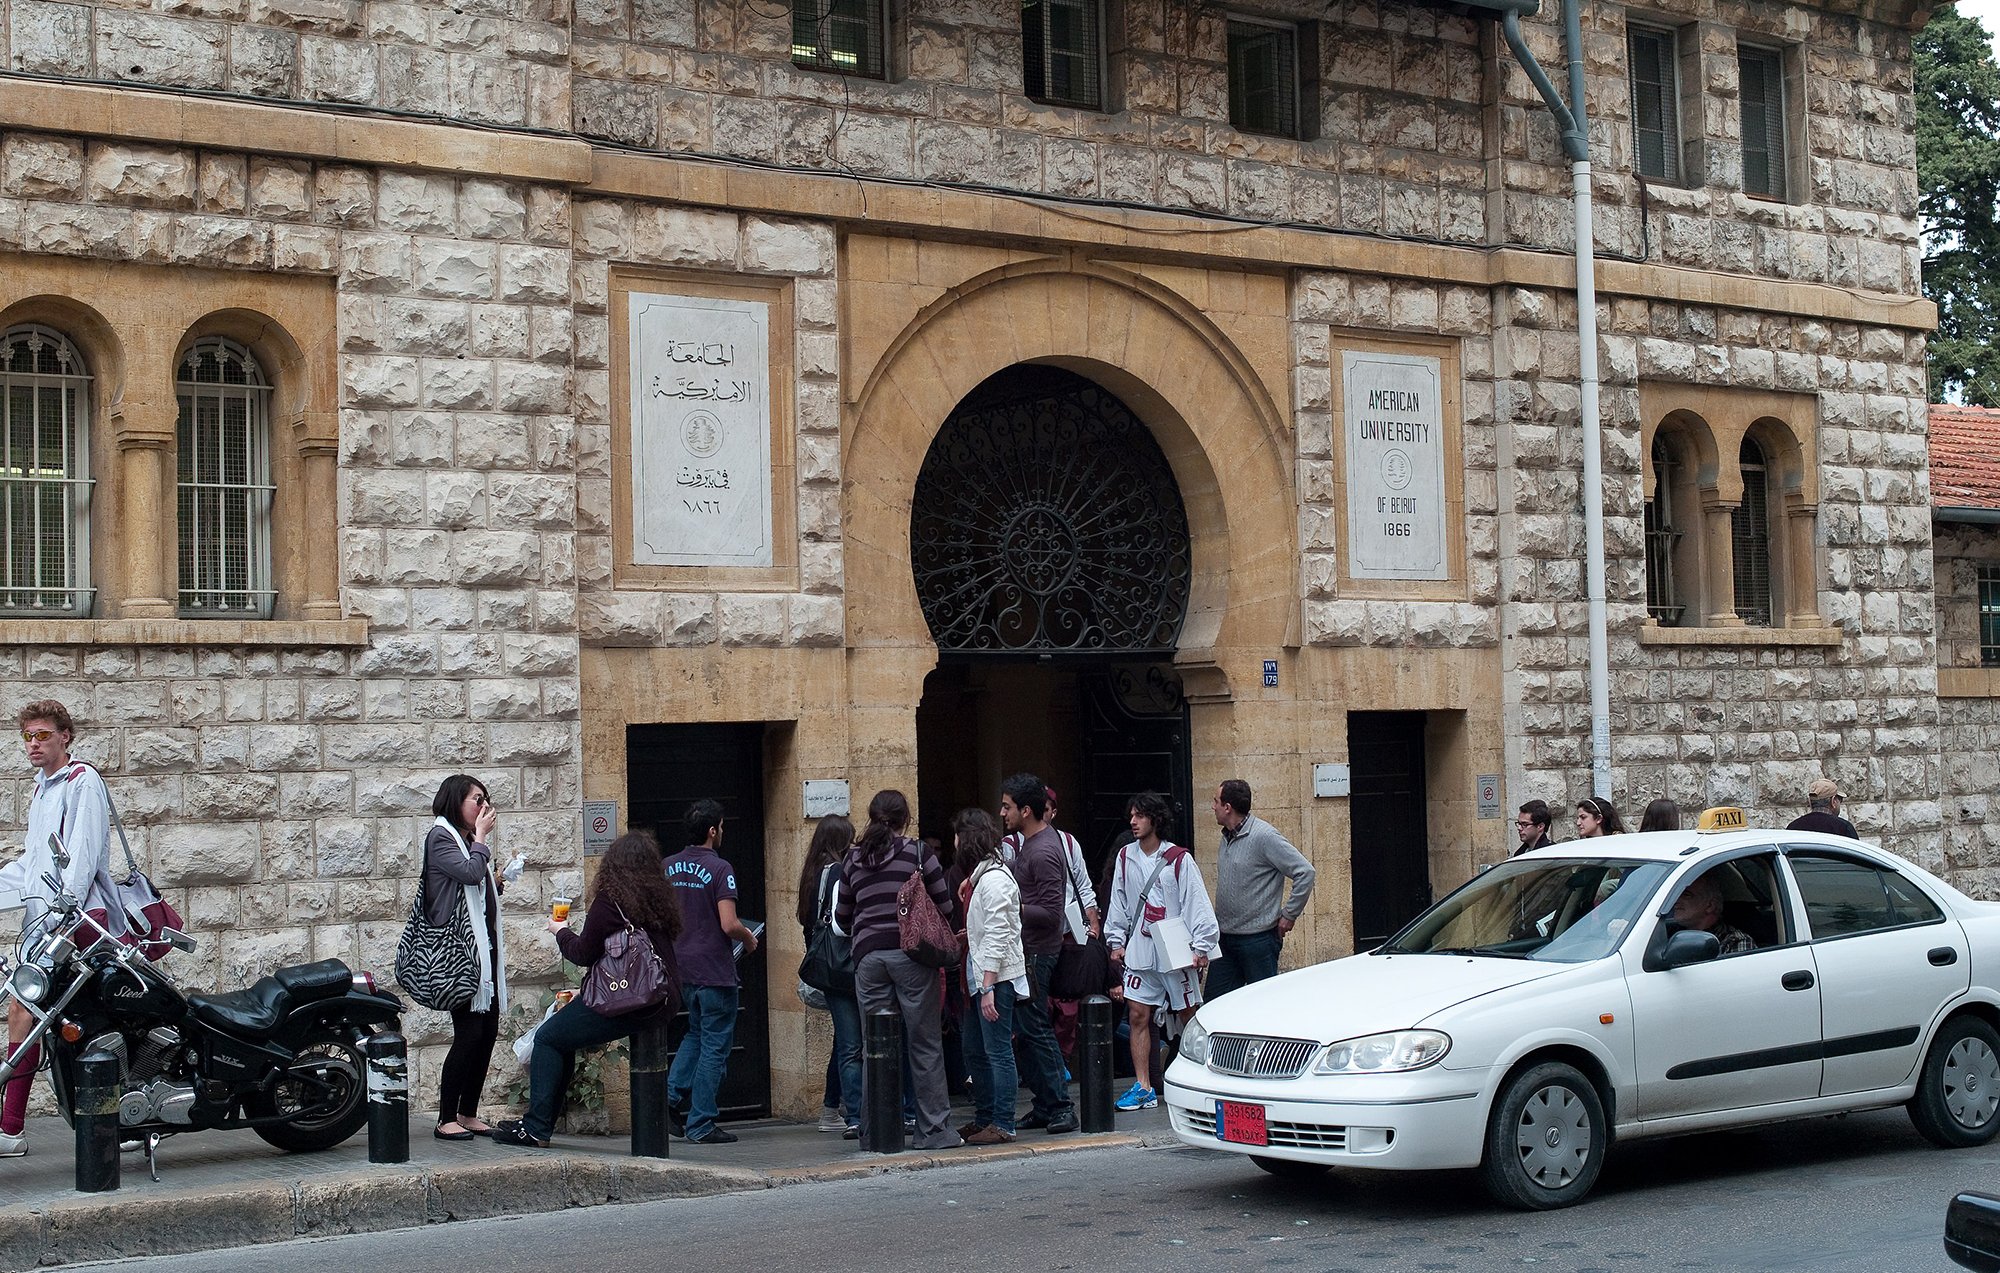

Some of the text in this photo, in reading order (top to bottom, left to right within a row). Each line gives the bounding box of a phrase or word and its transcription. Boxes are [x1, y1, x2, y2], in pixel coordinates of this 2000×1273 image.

[1368, 389, 1420, 413] AMERICAN
[1360, 419, 1429, 444] UNIVERSITY
[682, 499, 721, 514] ١٨٦٦
[1377, 496, 1417, 515] OF BEIRUT
[1383, 522, 1411, 537] 1866
[1264, 661, 1277, 672] ١٧٩
[1265, 675, 1277, 685] 179
[1714, 811, 1743, 827] TAXI
[726, 874, 737, 890] 8
[1126, 973, 1142, 990] 10
[1229, 1104, 1262, 1120] 391582
